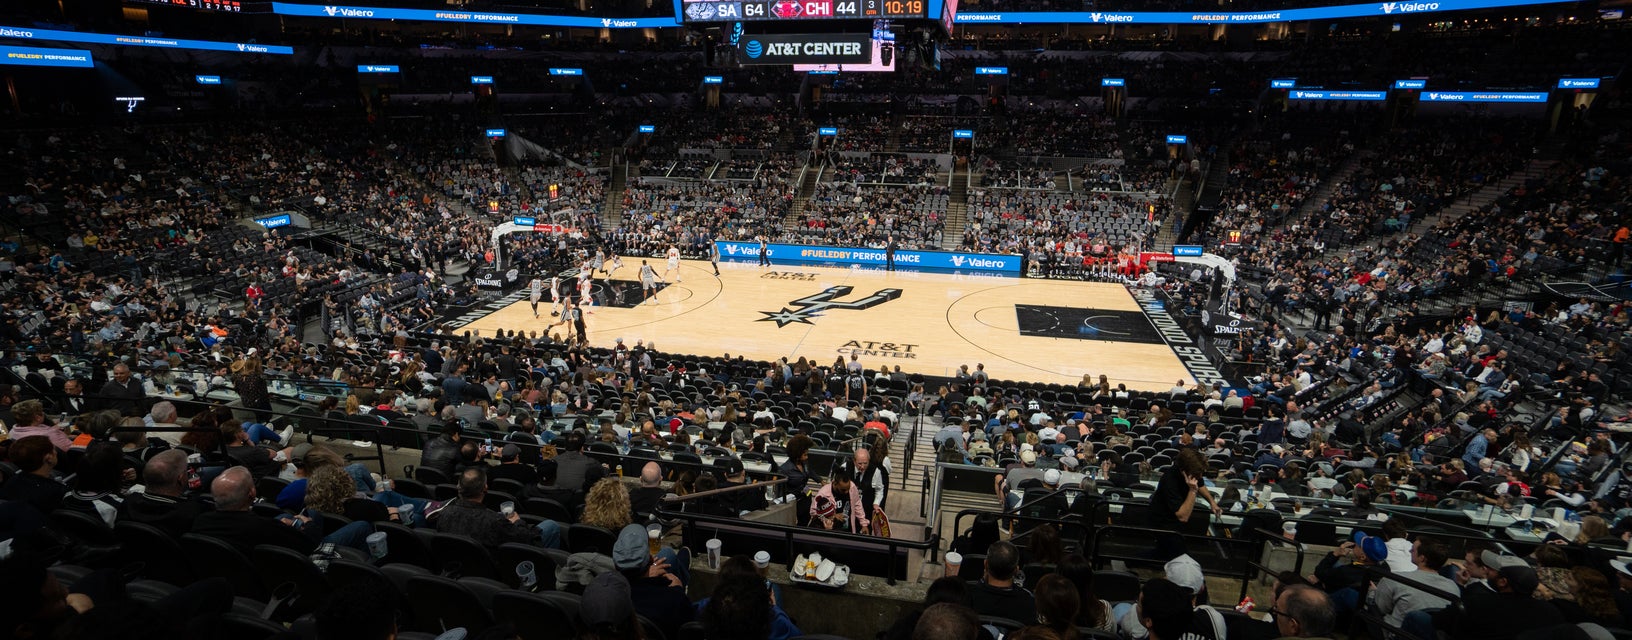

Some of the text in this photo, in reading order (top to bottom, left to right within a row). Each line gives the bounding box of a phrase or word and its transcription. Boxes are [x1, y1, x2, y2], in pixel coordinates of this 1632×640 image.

[340, 8, 374, 17] Valero
[718, 5, 737, 16] SA
[745, 4, 764, 16] 64
[806, 2, 830, 15] CHI
[836, 2, 856, 14] 44
[885, 1, 922, 13] 10:19
[1399, 2, 1440, 12] Valero
[766, 42, 861, 55] AT&T CENTER
[740, 246, 1005, 268] Valeo #FUELEDBY PERFORANCE Valero
[475, 278, 502, 287] SPALDING
[442, 309, 493, 328] SAN
[842, 340, 919, 352] AT&T
[837, 348, 918, 359] CENTER
[1174, 346, 1231, 387] SPURS
